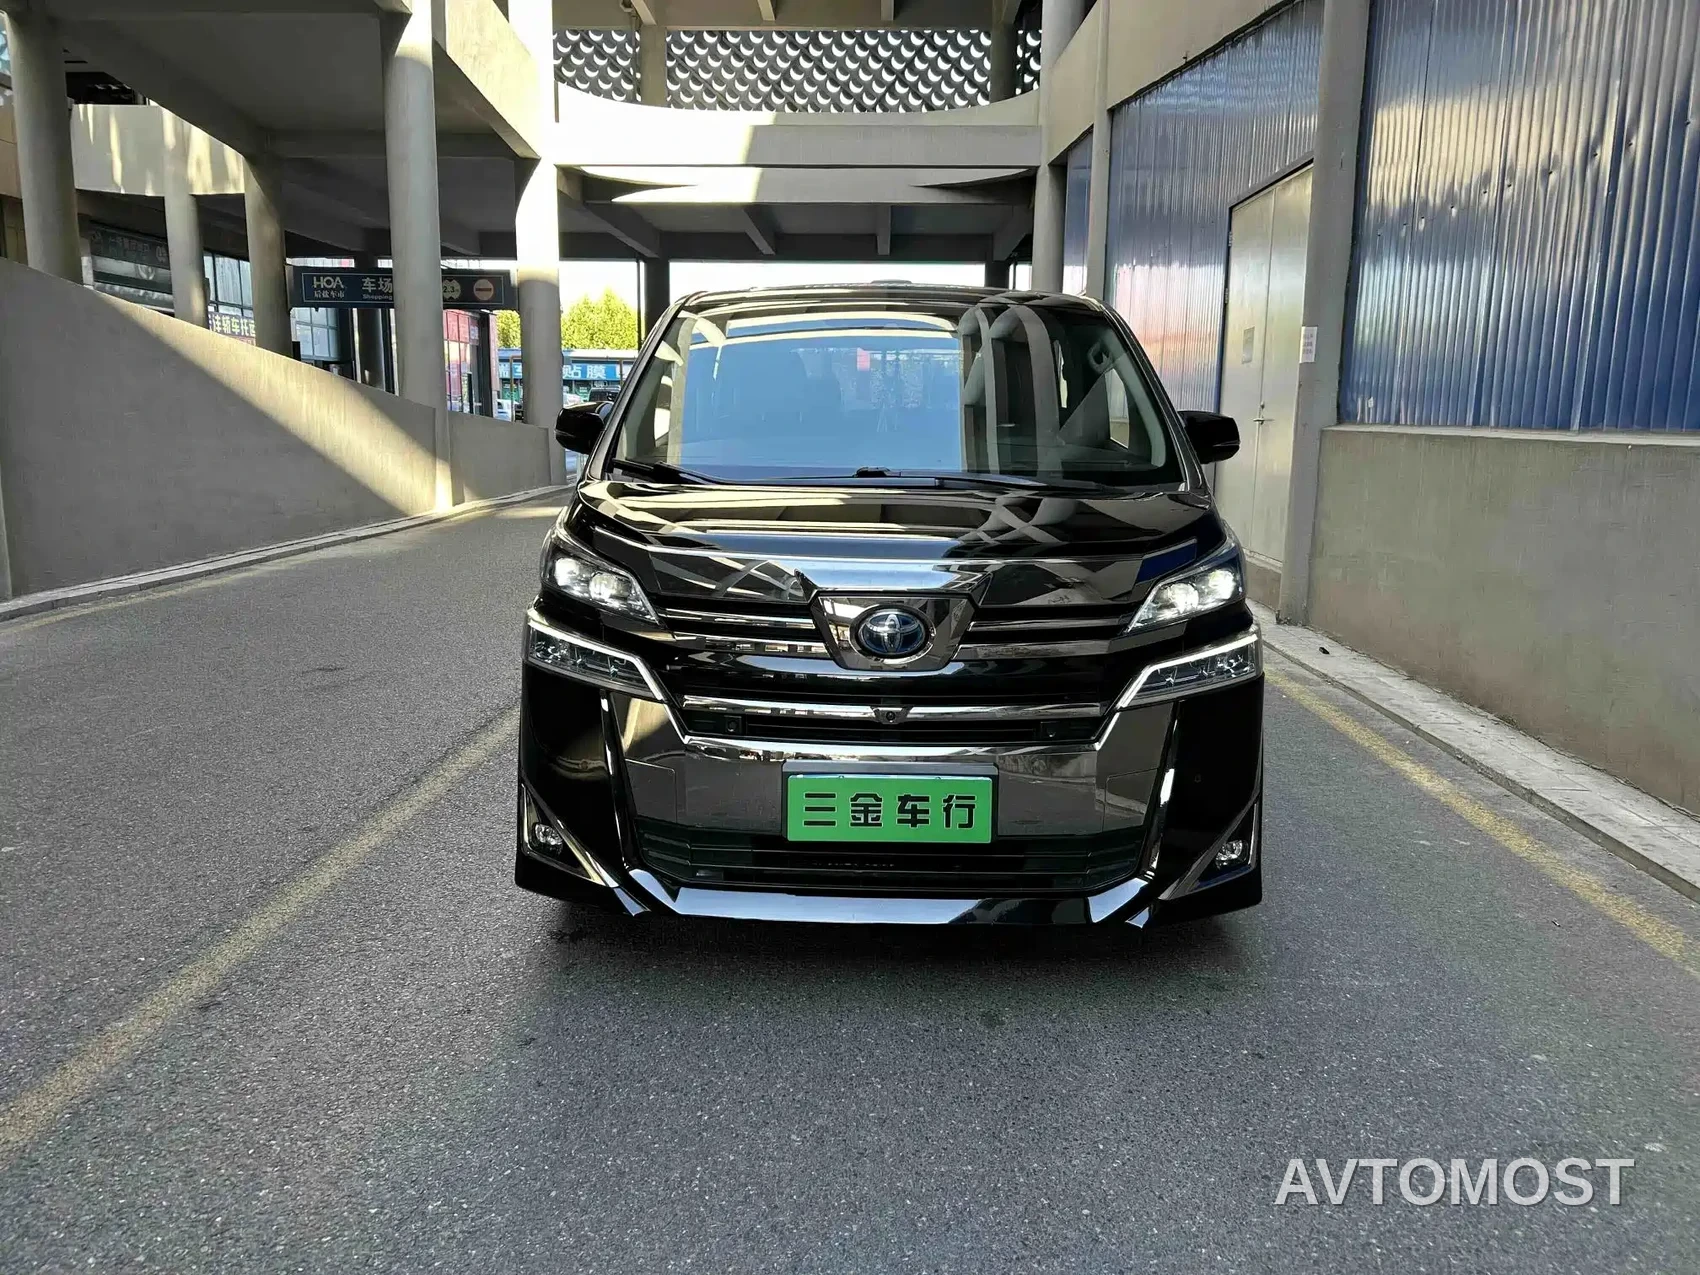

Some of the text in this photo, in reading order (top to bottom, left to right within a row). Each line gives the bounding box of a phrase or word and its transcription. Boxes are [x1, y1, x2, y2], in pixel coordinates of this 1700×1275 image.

[313, 276, 344, 289] HOA
[803, 792, 977, 829] 三金车行
